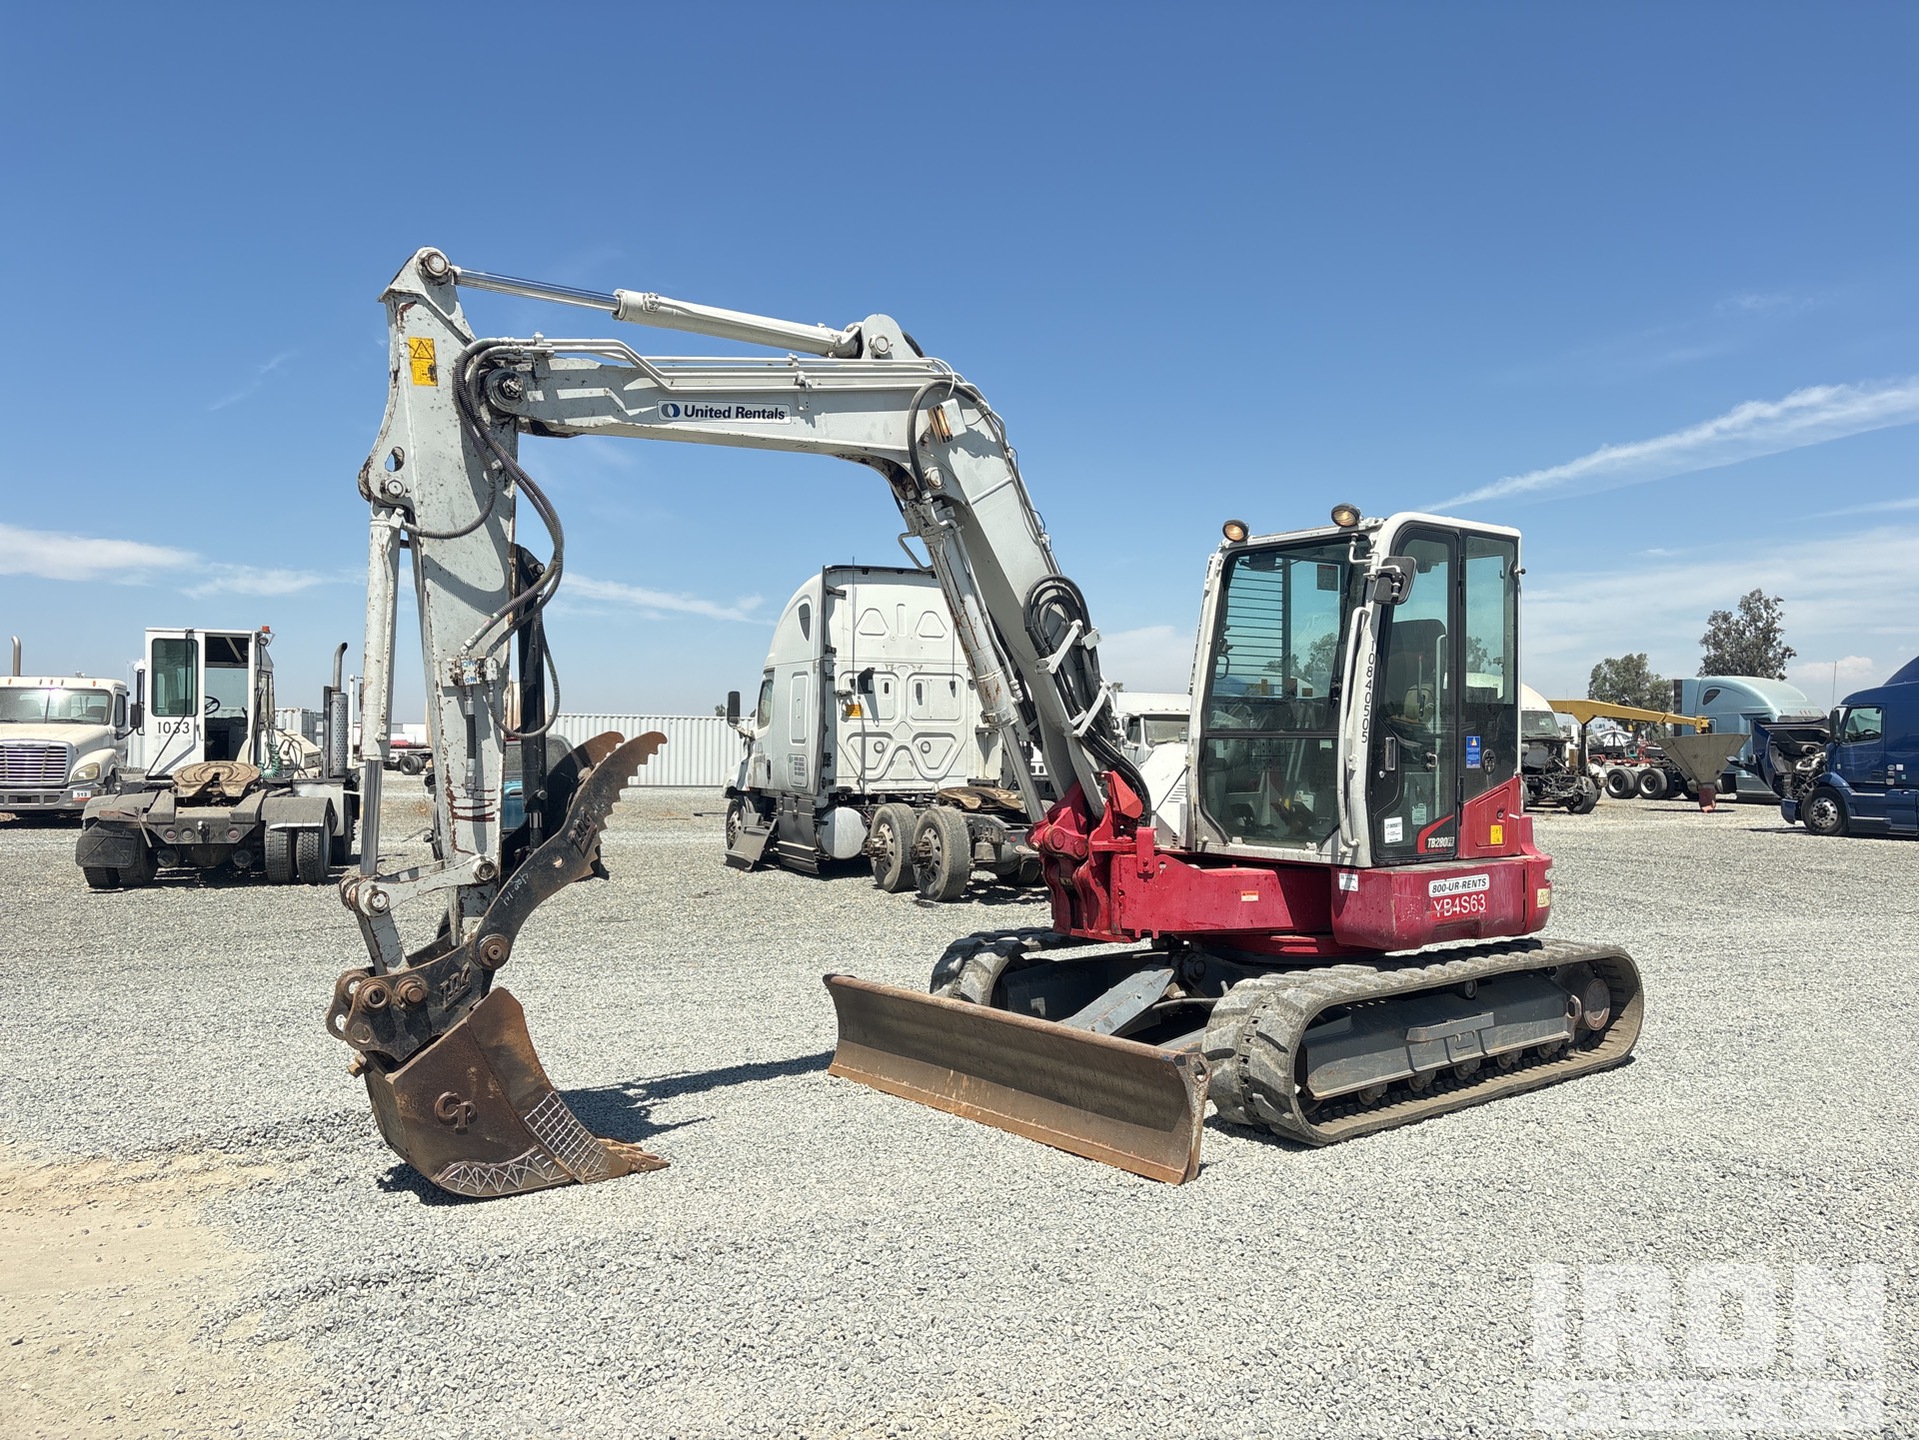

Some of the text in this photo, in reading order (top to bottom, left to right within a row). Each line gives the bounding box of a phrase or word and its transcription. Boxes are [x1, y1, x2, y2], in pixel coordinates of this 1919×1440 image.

[683, 404, 786, 421] United Rentals
[1360, 640, 1376, 743] 10840505
[157, 721, 190, 735] 1033
[1431, 878, 1488, 895] 800-UR-RENTS
[1433, 893, 1487, 920] YB4S63
